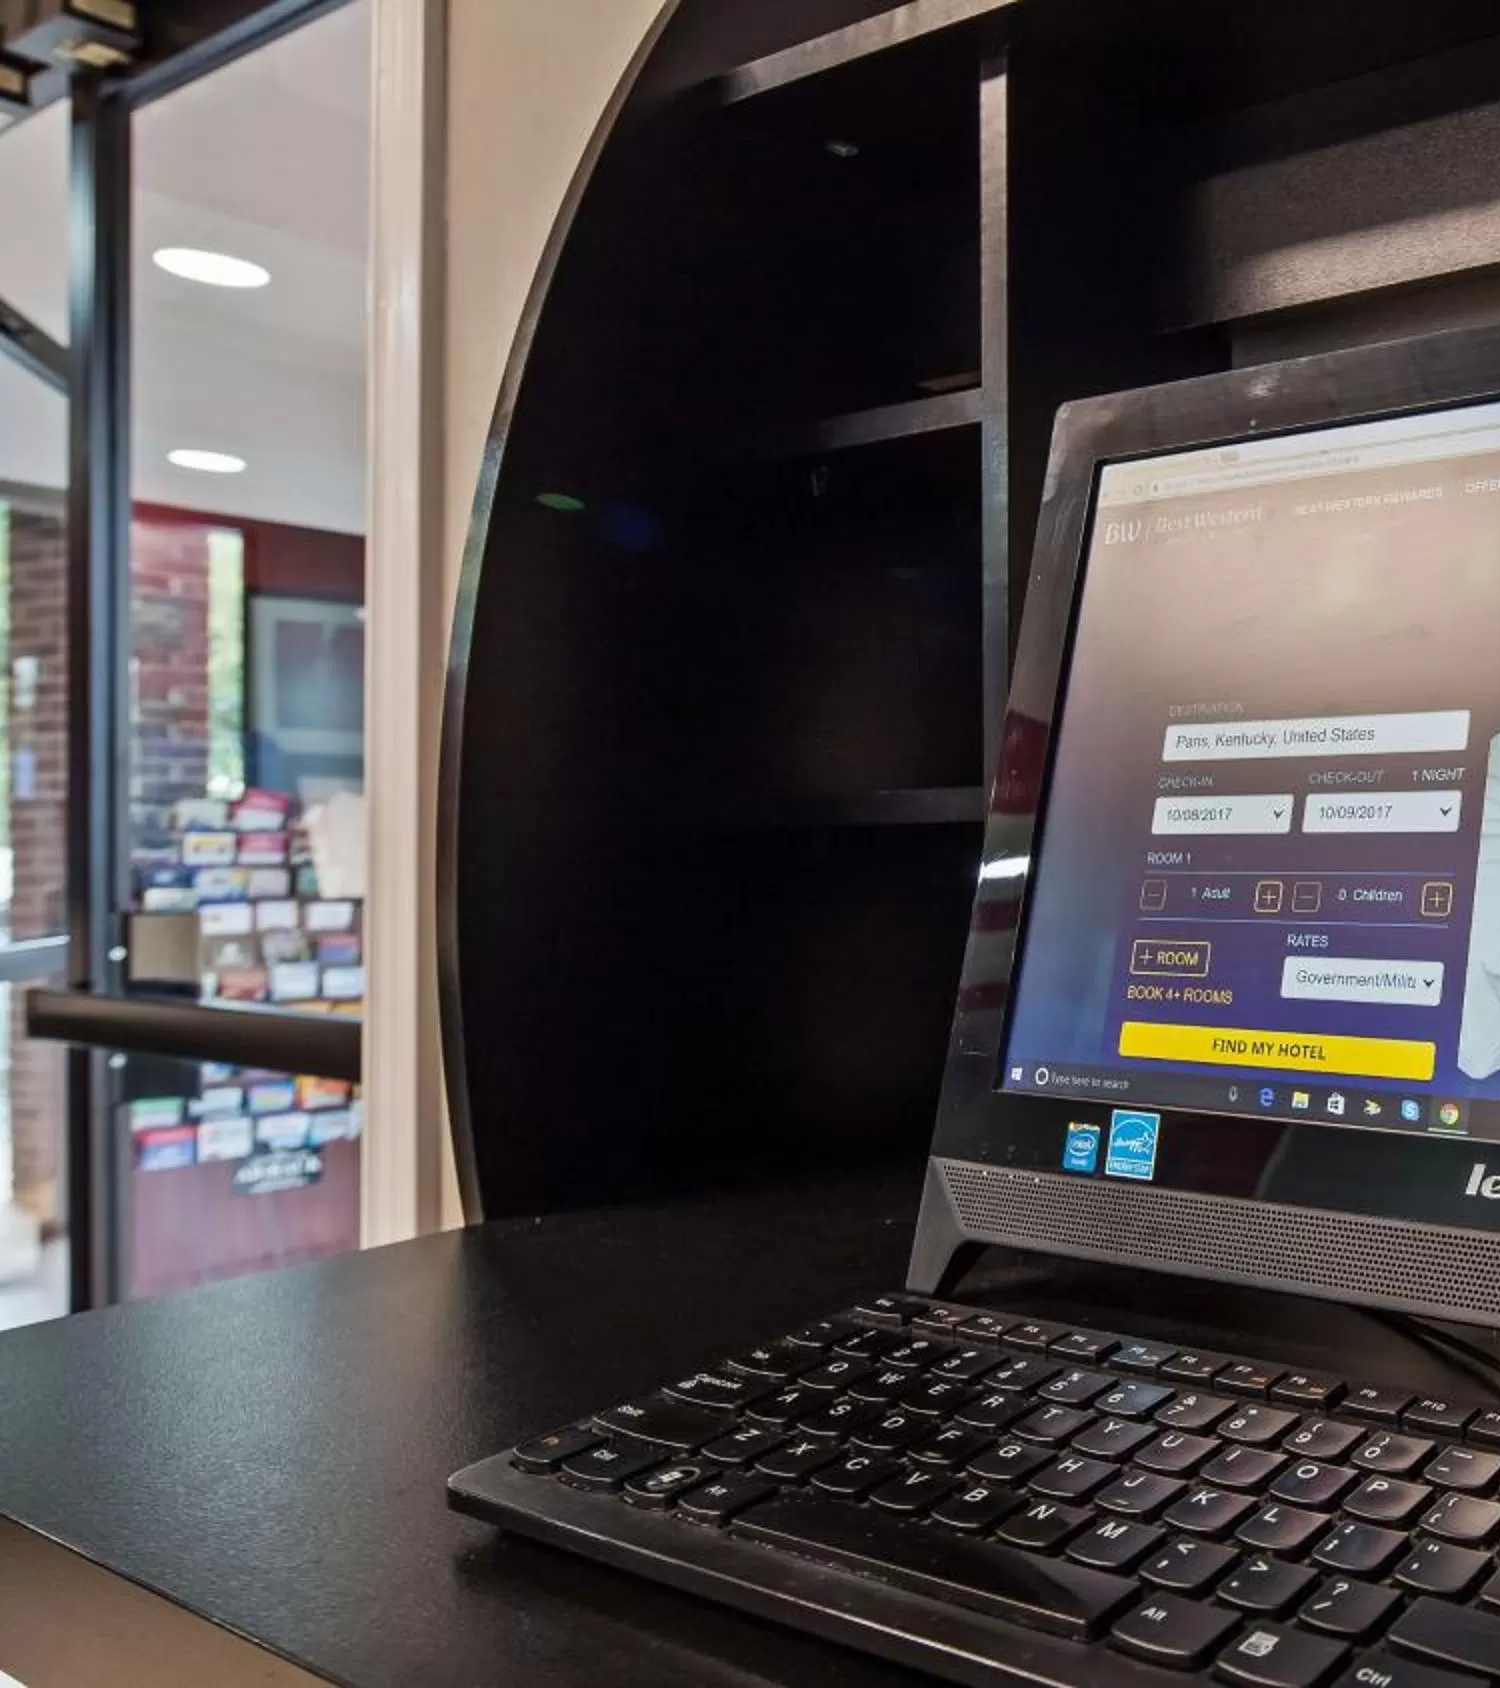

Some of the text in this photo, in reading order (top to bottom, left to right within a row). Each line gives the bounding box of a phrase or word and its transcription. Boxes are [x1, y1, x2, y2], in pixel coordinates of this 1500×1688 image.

[1283, 729, 1327, 745] United
[1331, 726, 1375, 743] States
[1308, 769, 1387, 785] CHECK-OUT
[1421, 766, 1465, 783] NIGHT
[1319, 804, 1392, 820] 10/09/2017
[1146, 852, 1183, 865] ROOM
[1353, 887, 1404, 902] Children
[1287, 934, 1329, 949] RATES
[1157, 951, 1199, 966] ROOM
[1127, 985, 1163, 1001] BOOK
[1183, 988, 1233, 1005] ROOMS
[1212, 1039, 1327, 1061] FIND MY HOTEL
[1107, 1392, 1126, 1403] 6
[828, 1404, 852, 1418] S
[1043, 1407, 1066, 1420] T
[1103, 1421, 1125, 1434] Y
[1229, 1418, 1248, 1430] 8
[1161, 1434, 1186, 1448] U
[1295, 1431, 1313, 1444] 9
[844, 1456, 870, 1471] C
[1056, 1458, 1084, 1474] H
[904, 1470, 931, 1486] V
[1296, 1464, 1320, 1480] O
[1123, 1474, 1147, 1488] J
[1366, 1480, 1390, 1493] P
[962, 1487, 990, 1502] B
[1191, 1490, 1219, 1506] K
[1026, 1503, 1057, 1521] N
[1262, 1506, 1280, 1524] L
[1095, 1521, 1129, 1540] M
[1140, 1605, 1168, 1623] Alt
[1354, 1665, 1394, 1687] Ctrl
